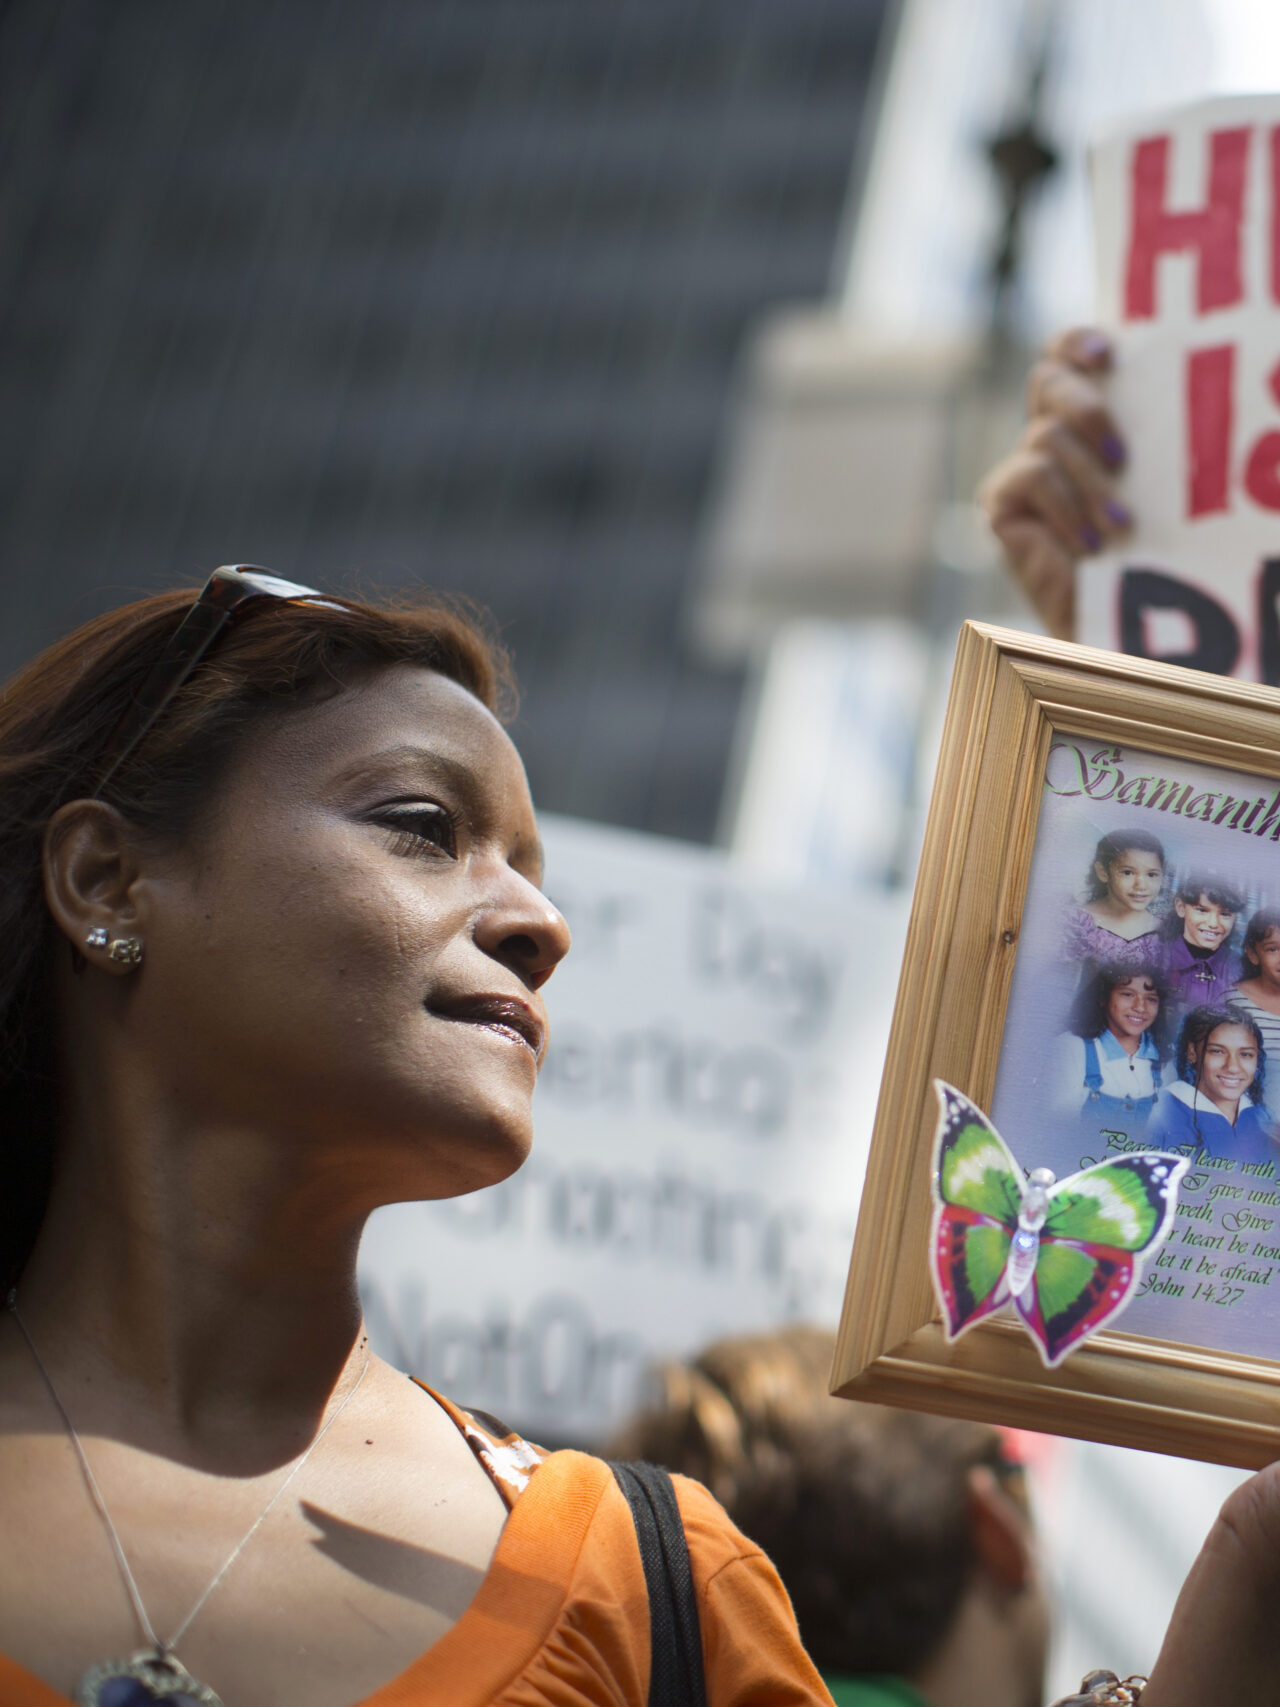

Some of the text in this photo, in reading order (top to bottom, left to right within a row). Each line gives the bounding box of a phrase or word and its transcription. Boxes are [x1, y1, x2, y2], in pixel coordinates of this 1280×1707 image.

[1195, 1147, 1237, 1171] leave
[1240, 1160, 1275, 1179] with
[1205, 1184, 1244, 1202] give
[1176, 1200, 1213, 1223] iveth,
[1222, 1208, 1275, 1232] Give
[1181, 1226, 1225, 1249] heart
[1227, 1234, 1249, 1253] be
[1155, 1248, 1176, 1268] let
[1180, 1256, 1193, 1271] it
[1196, 1256, 1217, 1275] be
[1134, 1273, 1185, 1297] John
